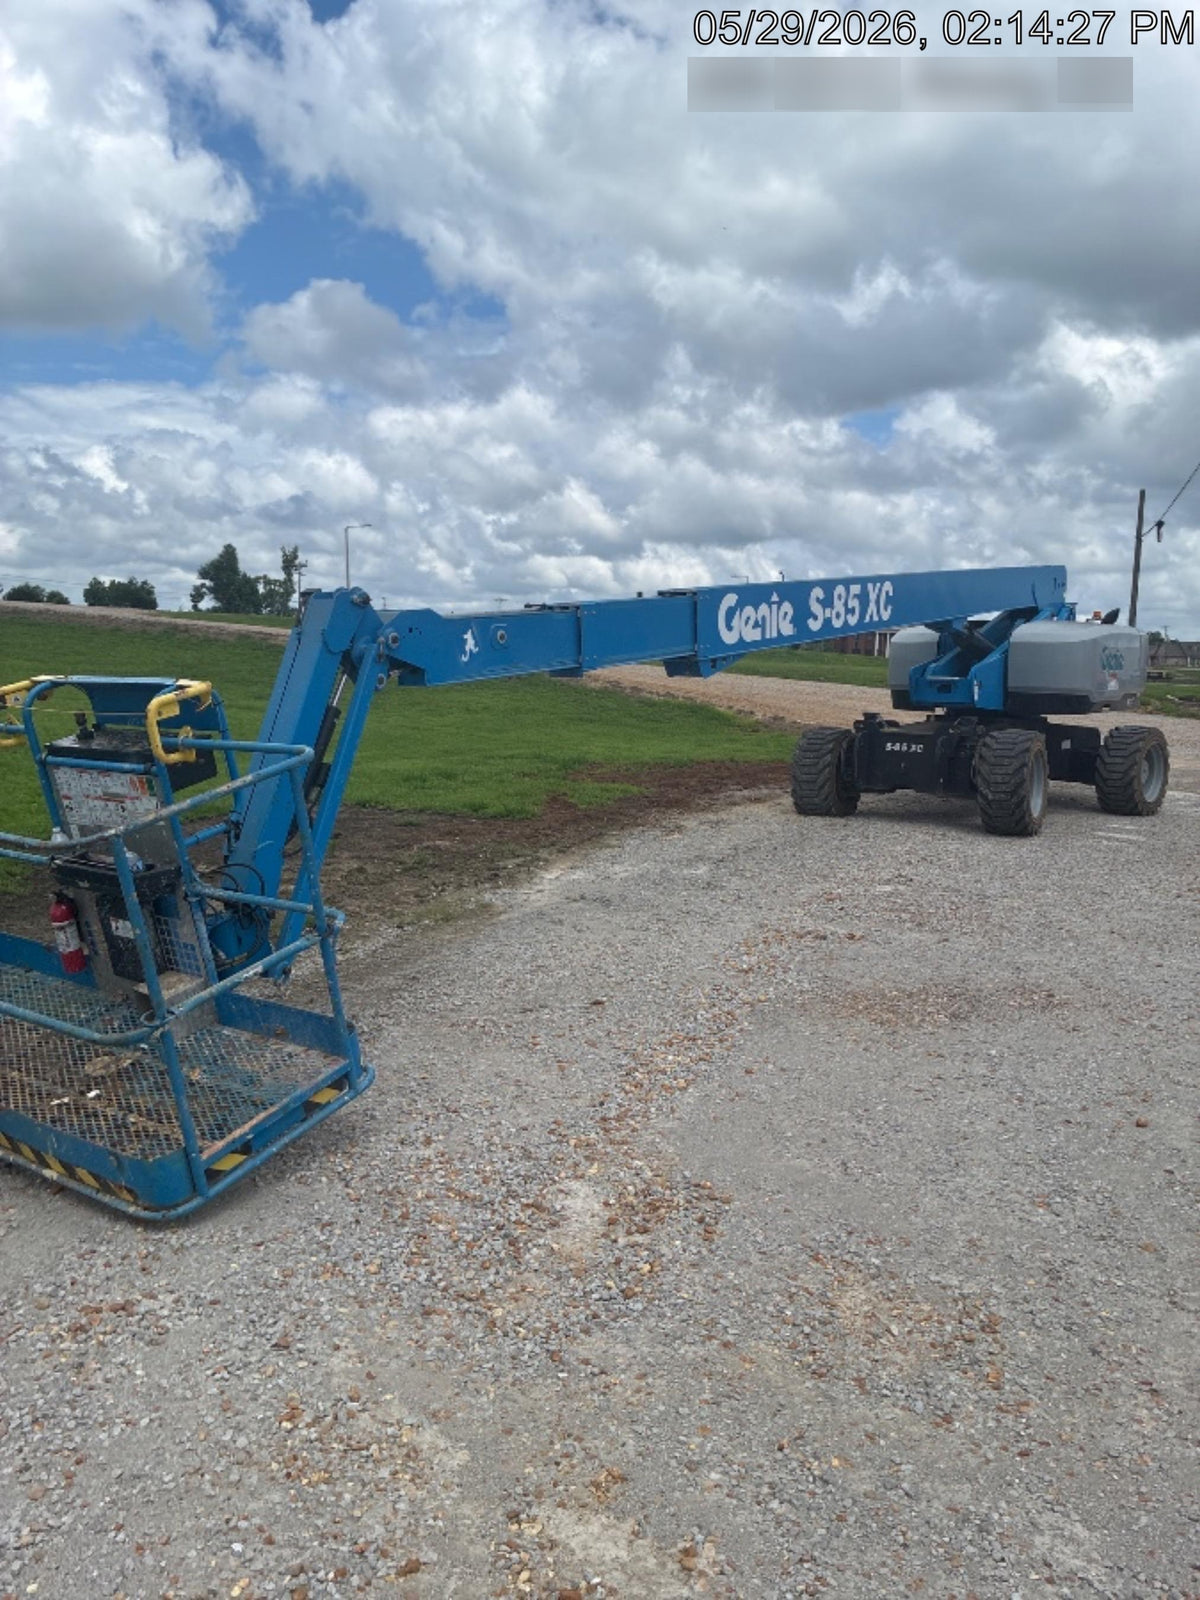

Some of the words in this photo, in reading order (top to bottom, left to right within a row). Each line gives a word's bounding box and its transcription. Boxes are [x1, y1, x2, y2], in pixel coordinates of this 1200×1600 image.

[718, 592, 796, 645] Genie
[807, 584, 861, 632] S-85
[864, 581, 893, 623] XC
